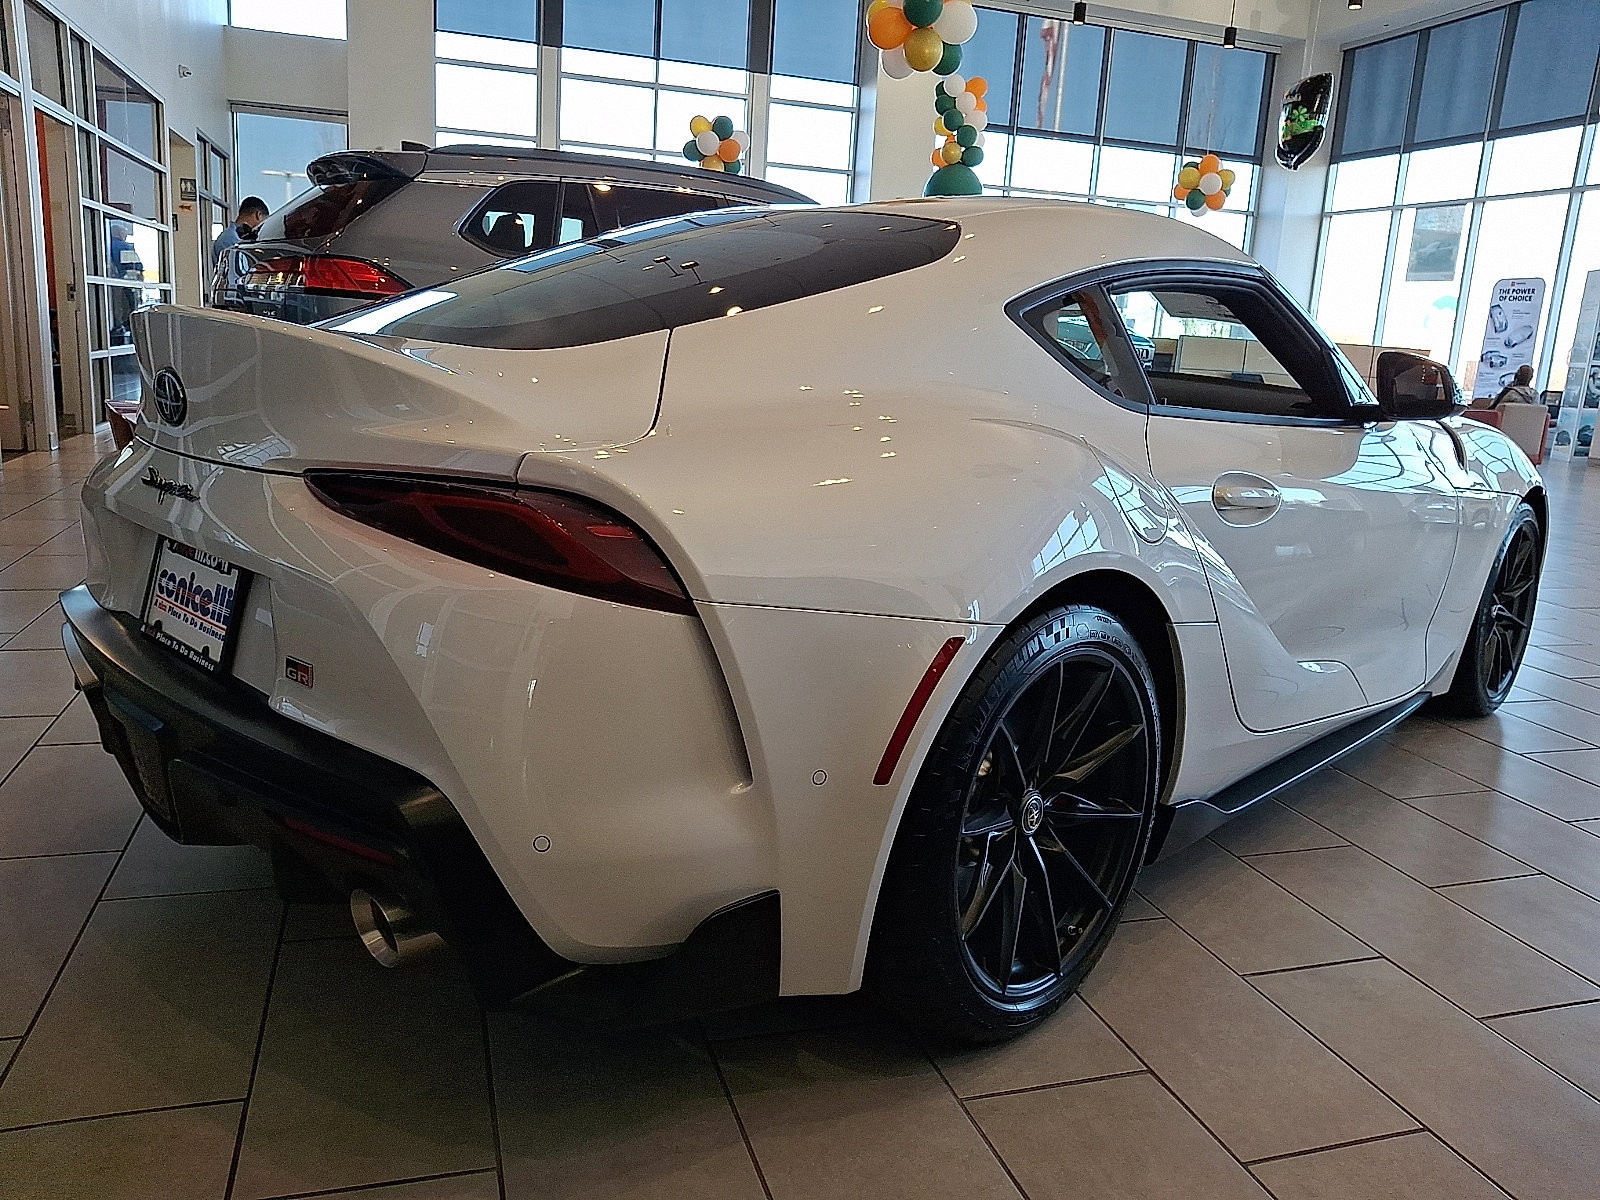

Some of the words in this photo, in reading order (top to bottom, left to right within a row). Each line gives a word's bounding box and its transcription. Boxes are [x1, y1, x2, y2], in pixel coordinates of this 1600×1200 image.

[168, 605, 182, 620] Place
[182, 613, 189, 623] To
[189, 617, 198, 628] Do
[198, 621, 227, 642] Business
[155, 632, 172, 646] Place
[171, 640, 179, 650] To
[179, 644, 189, 656] Do
[188, 651, 215, 672] Business
[286, 667, 309, 685] GR
